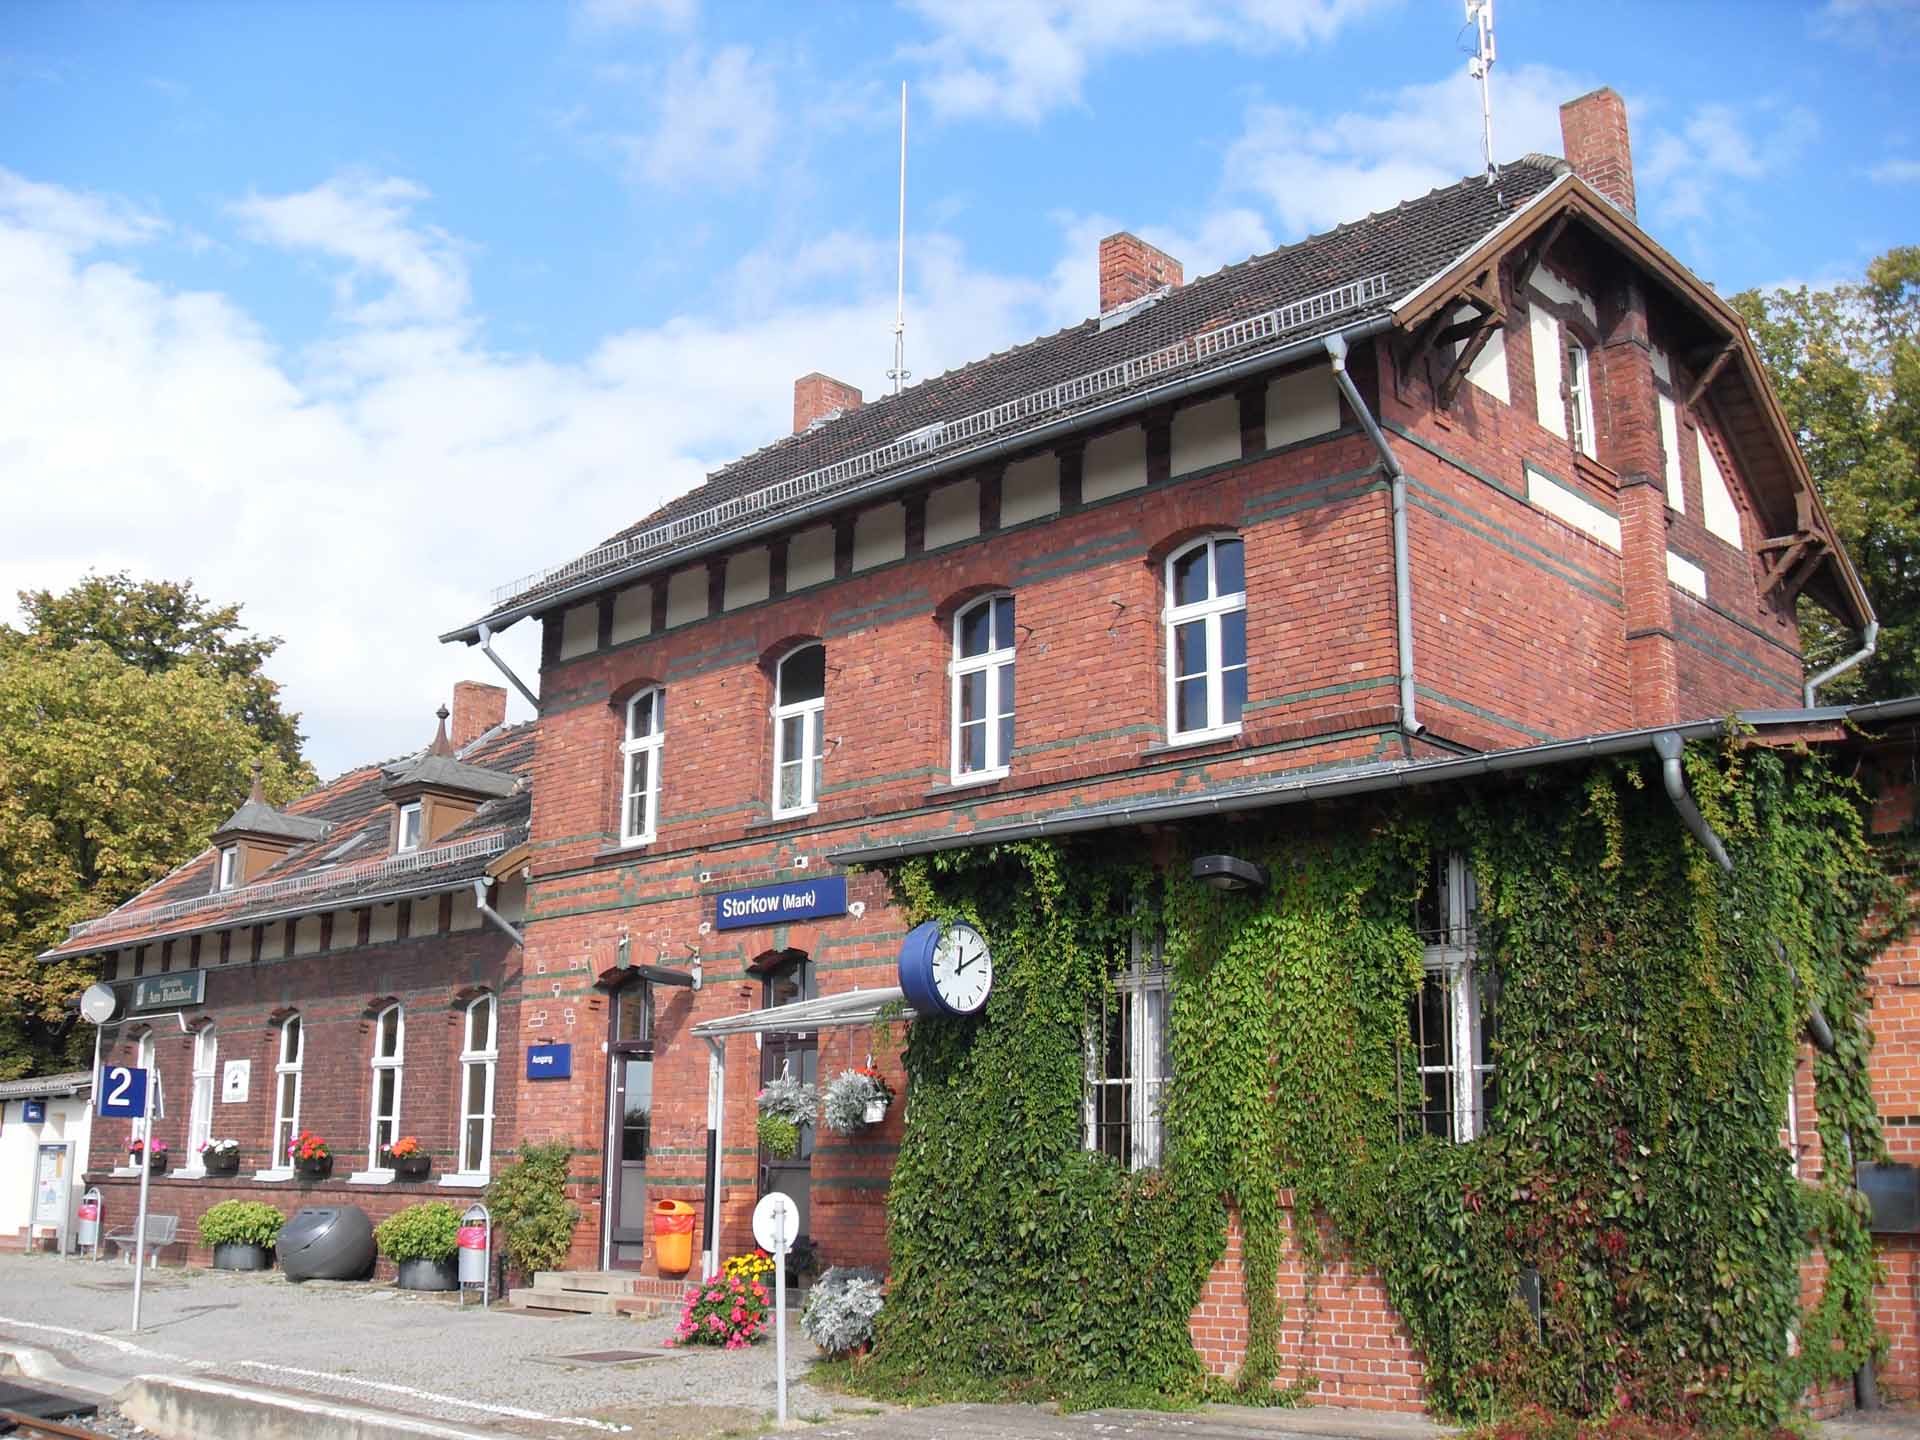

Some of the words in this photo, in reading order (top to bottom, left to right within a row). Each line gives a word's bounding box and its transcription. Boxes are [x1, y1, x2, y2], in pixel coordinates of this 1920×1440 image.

[722, 895, 780, 918] Storkow
[782, 889, 816, 911] (Mark)
[107, 1067, 132, 1106] 2
